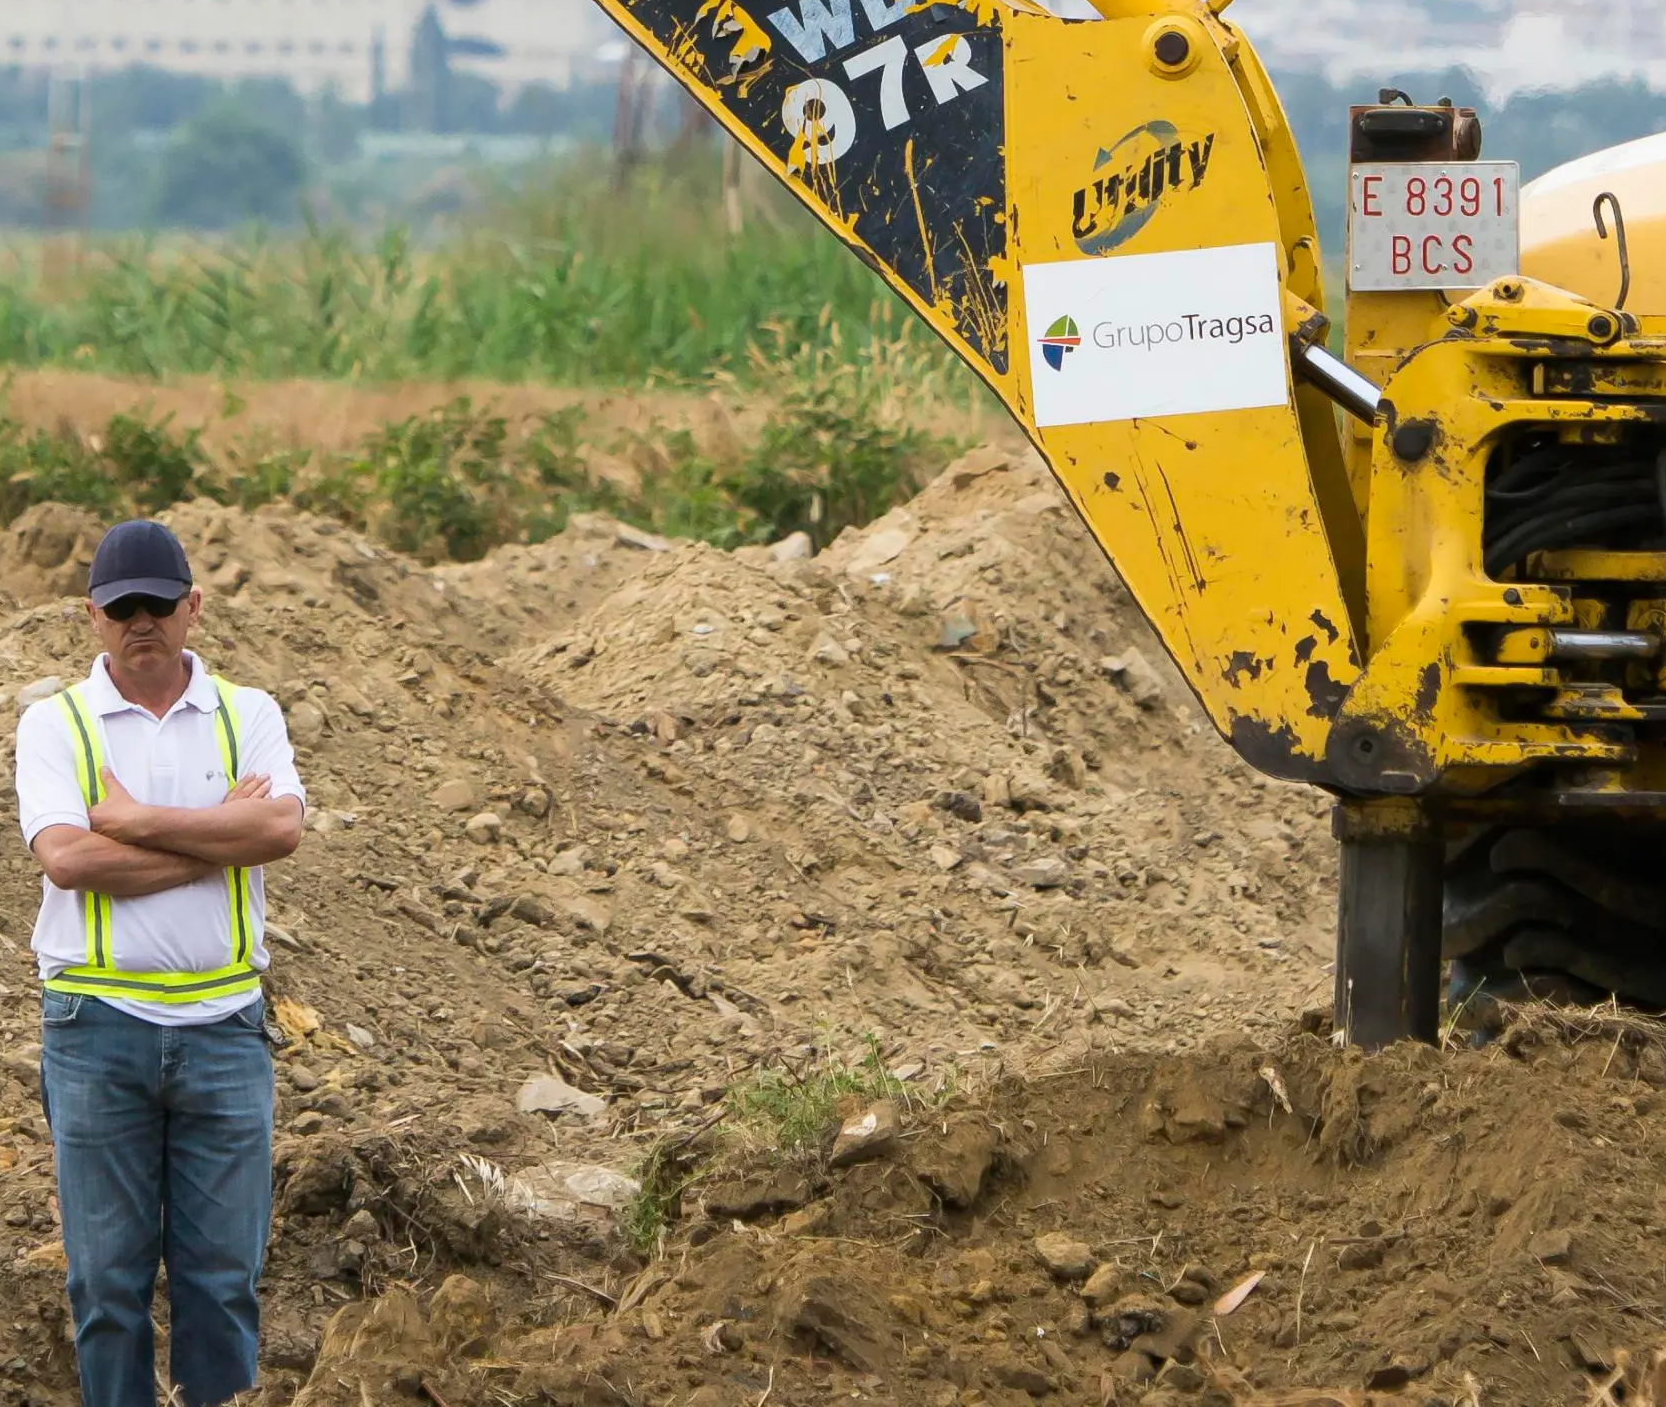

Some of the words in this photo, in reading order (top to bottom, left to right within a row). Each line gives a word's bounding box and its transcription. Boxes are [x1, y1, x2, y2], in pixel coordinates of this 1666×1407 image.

[781, 33, 990, 165] 97R
[1362, 176, 1383, 217] E
[1406, 176, 1503, 217] 8391
[1392, 234, 1473, 275] BCS
[1093, 313, 1275, 352] GrupoTragsa
